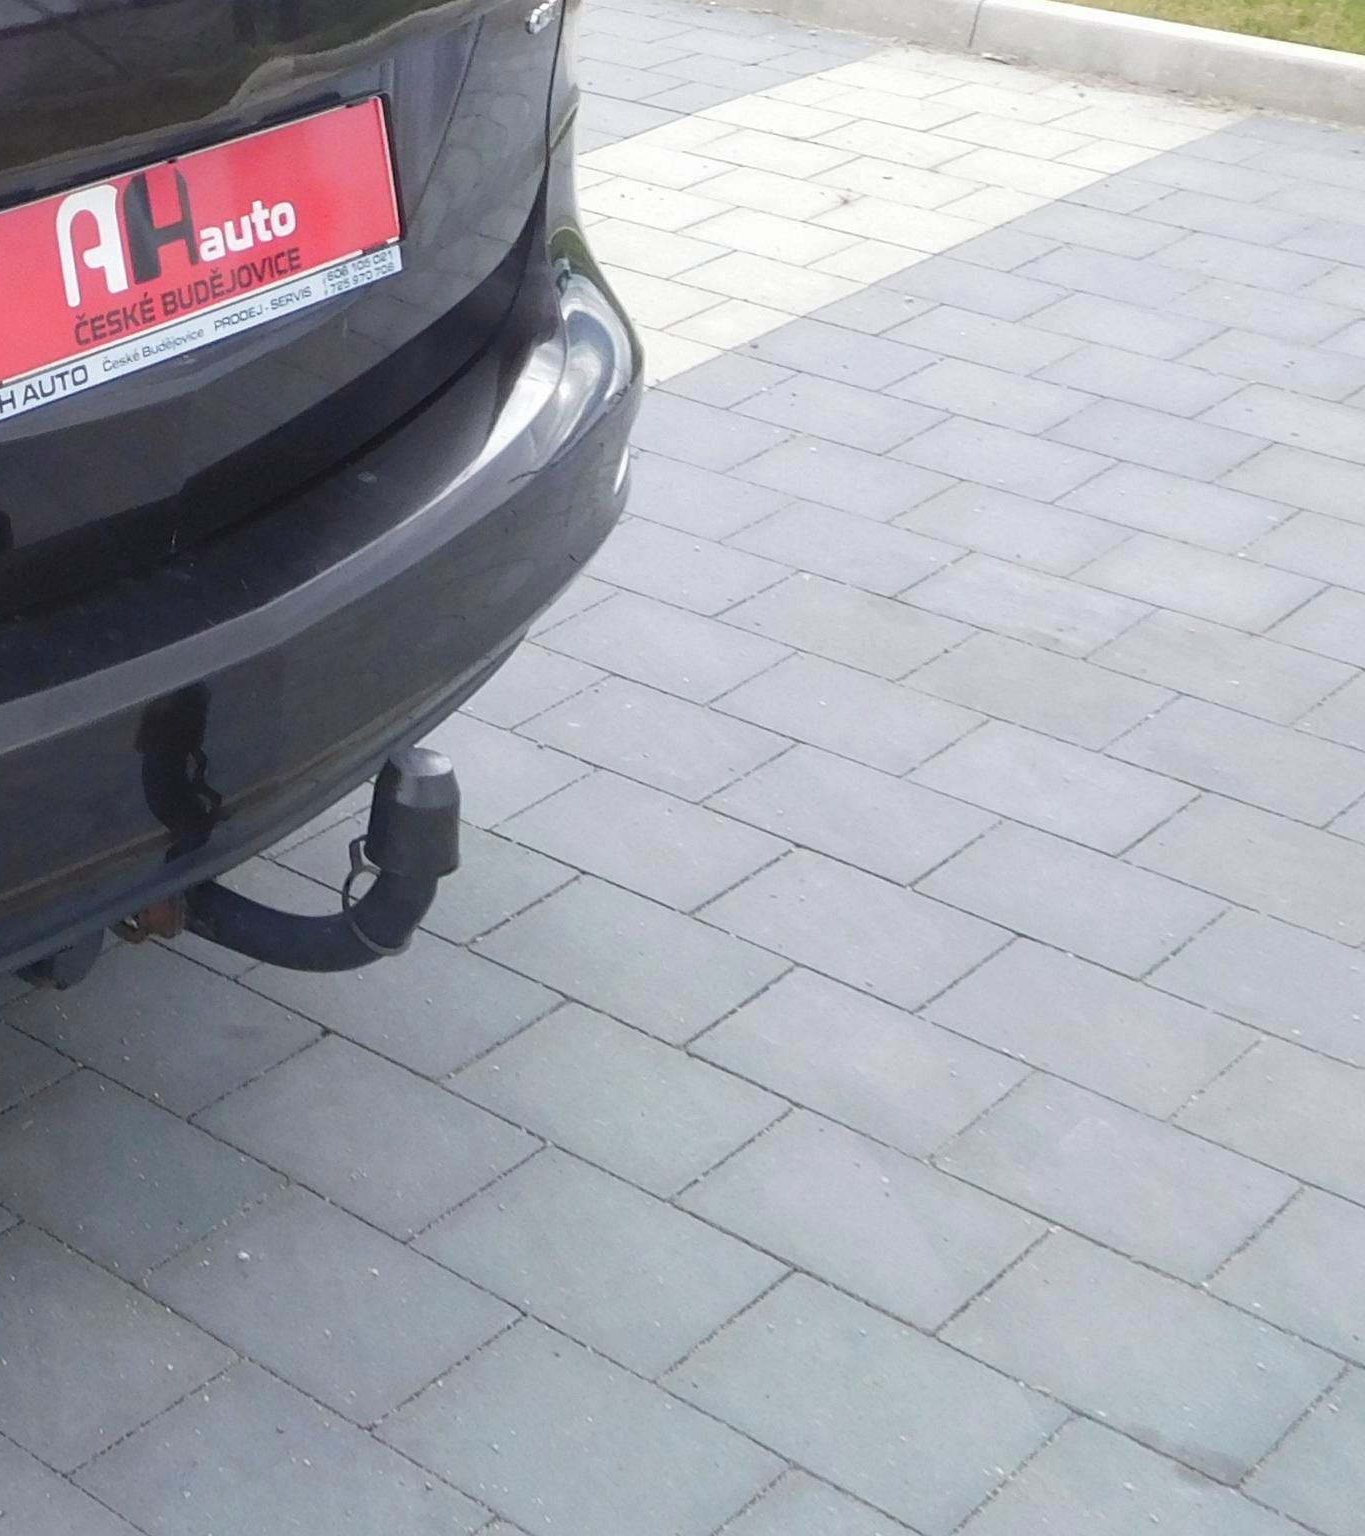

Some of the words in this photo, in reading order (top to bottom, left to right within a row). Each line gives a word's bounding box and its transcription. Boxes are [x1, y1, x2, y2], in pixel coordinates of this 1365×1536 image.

[22, 364, 89, 406] AUTO
[101, 351, 140, 372] České
[142, 328, 205, 358] Budějovice
[213, 306, 264, 331] PRODEJ
[270, 286, 312, 310] SERVIS
[73, 292, 156, 346] ČESKÉ
[160, 248, 302, 316] BUDĚJOVICE
